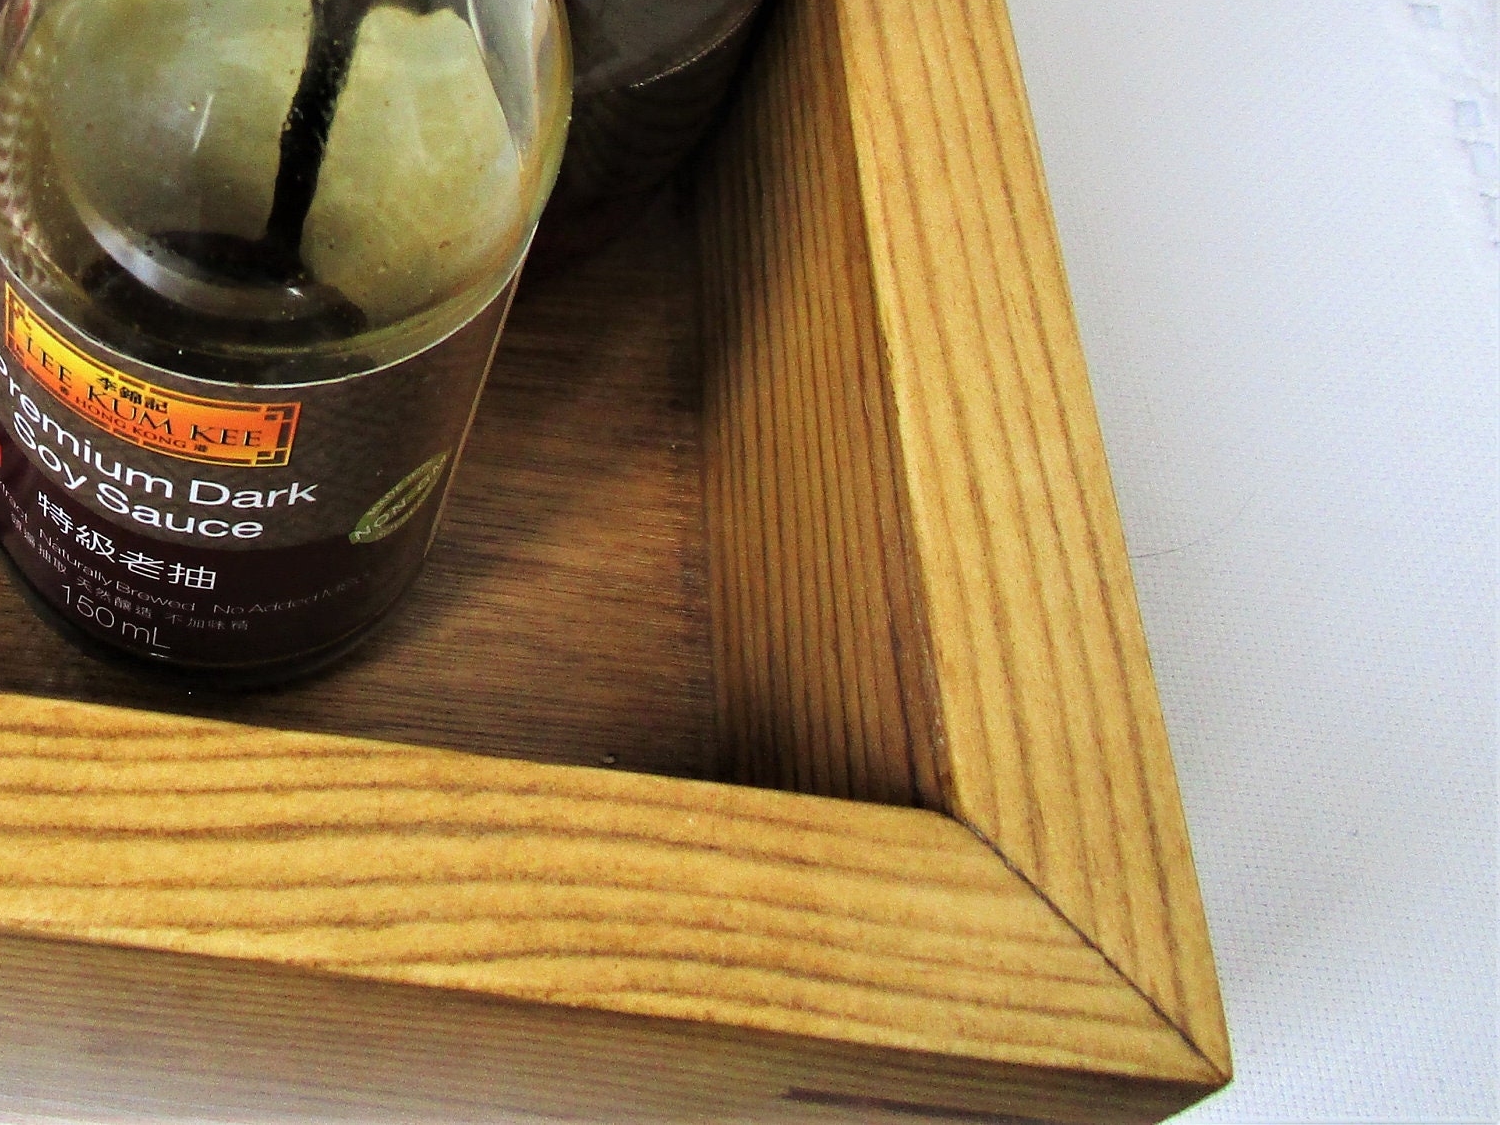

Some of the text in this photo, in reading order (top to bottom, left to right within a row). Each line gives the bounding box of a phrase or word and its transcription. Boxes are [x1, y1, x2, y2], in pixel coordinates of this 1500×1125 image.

[26, 336, 263, 448] LEE KUM KEE
[75, 396, 187, 450] HONG KONG
[13, 411, 88, 490] Soy
[95, 480, 265, 540] Sauce
[187, 478, 320, 510] Dark
[37, 490, 217, 591] 特級老抽
[39, 528, 113, 586] Naturally
[116, 580, 196, 612] Brewed
[214, 604, 245, 616] No
[61, 584, 171, 651] 150 mL
